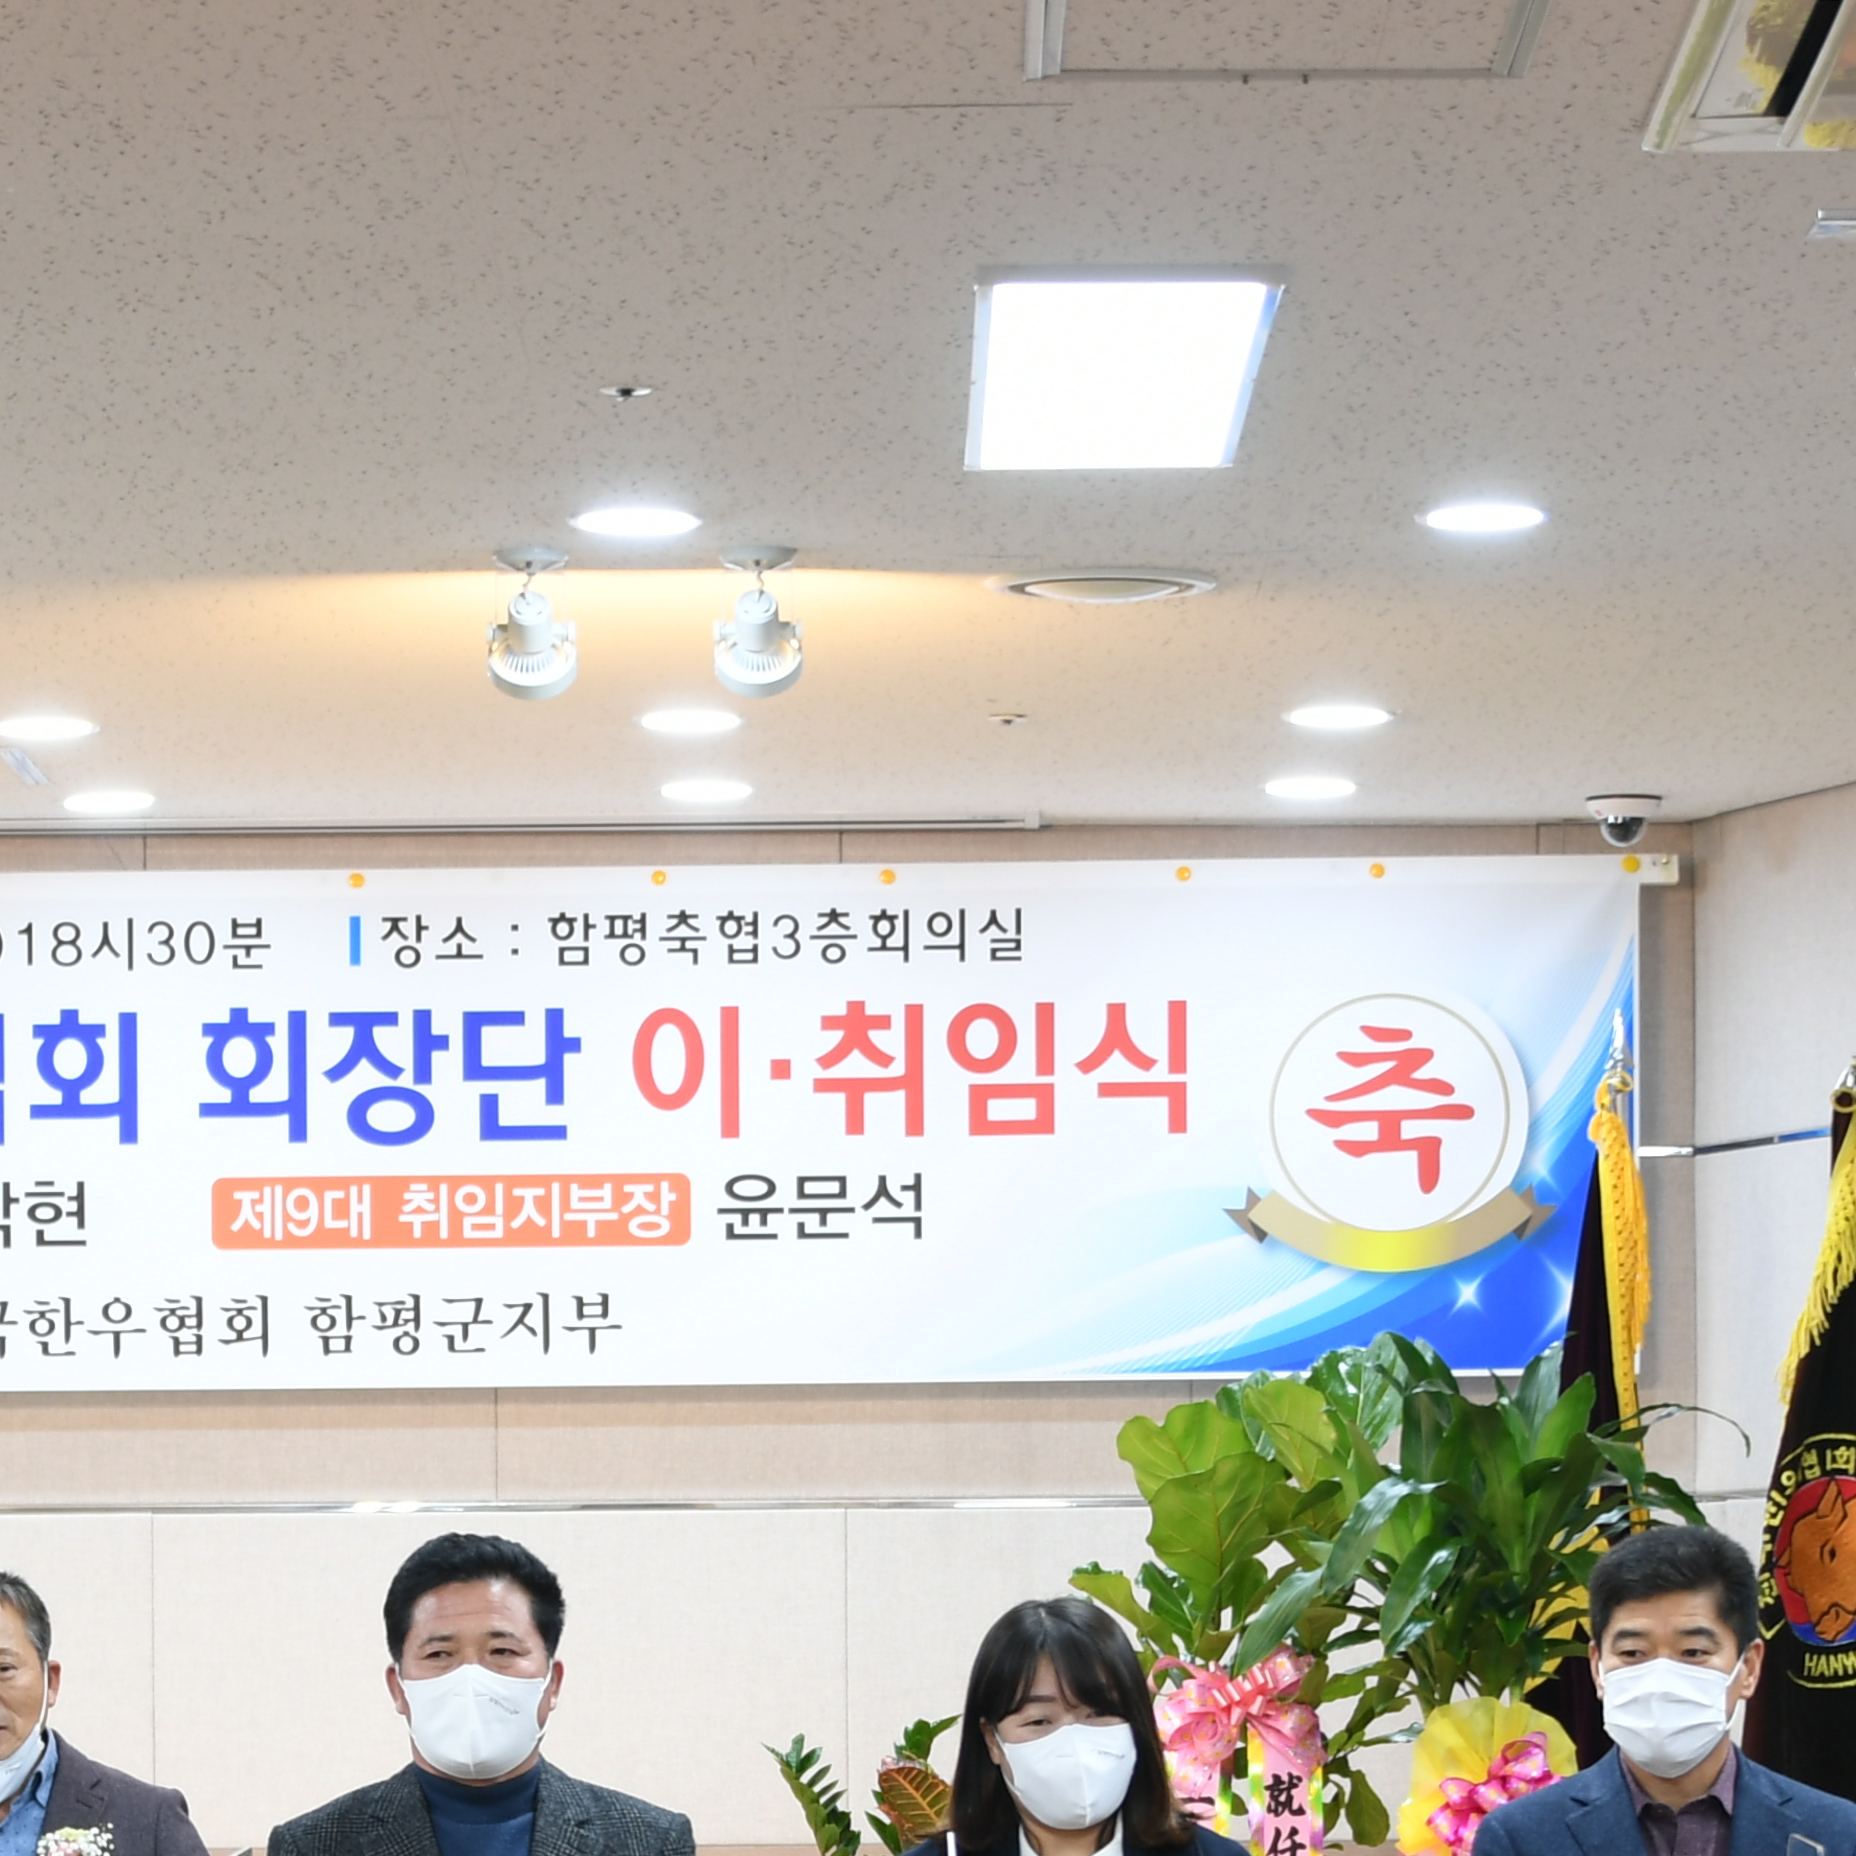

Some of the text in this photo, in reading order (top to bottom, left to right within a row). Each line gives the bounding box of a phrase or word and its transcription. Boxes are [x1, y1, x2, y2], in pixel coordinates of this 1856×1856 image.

[380, 913, 485, 970] 장소
[547, 906, 1023, 967] 함평축협3층회의실
[198, 1006, 583, 1147] 회장단
[1306, 1024, 1476, 1195] 축
[230, 1172, 923, 1241] 제9대 취임지부장 윤문석
[306, 1291, 623, 1357] 함평군지부
